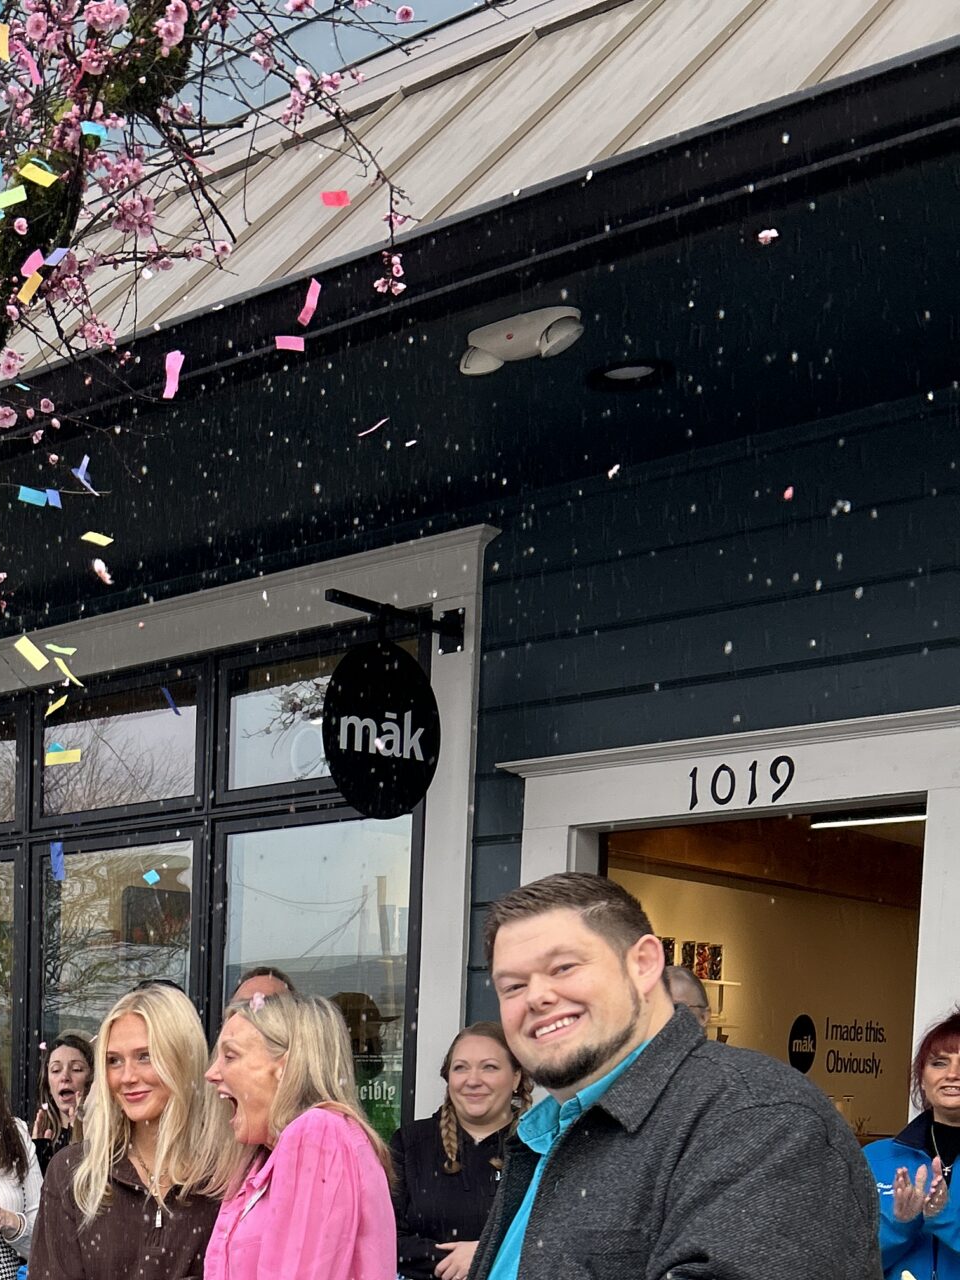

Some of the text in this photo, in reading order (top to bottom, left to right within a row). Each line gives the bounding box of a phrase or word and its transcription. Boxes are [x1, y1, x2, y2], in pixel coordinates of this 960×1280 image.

[340, 711, 425, 761] māk
[689, 755, 795, 811] 1019
[825, 1017, 887, 1042] I made this.
[826, 1049, 883, 1079] Obviously.
